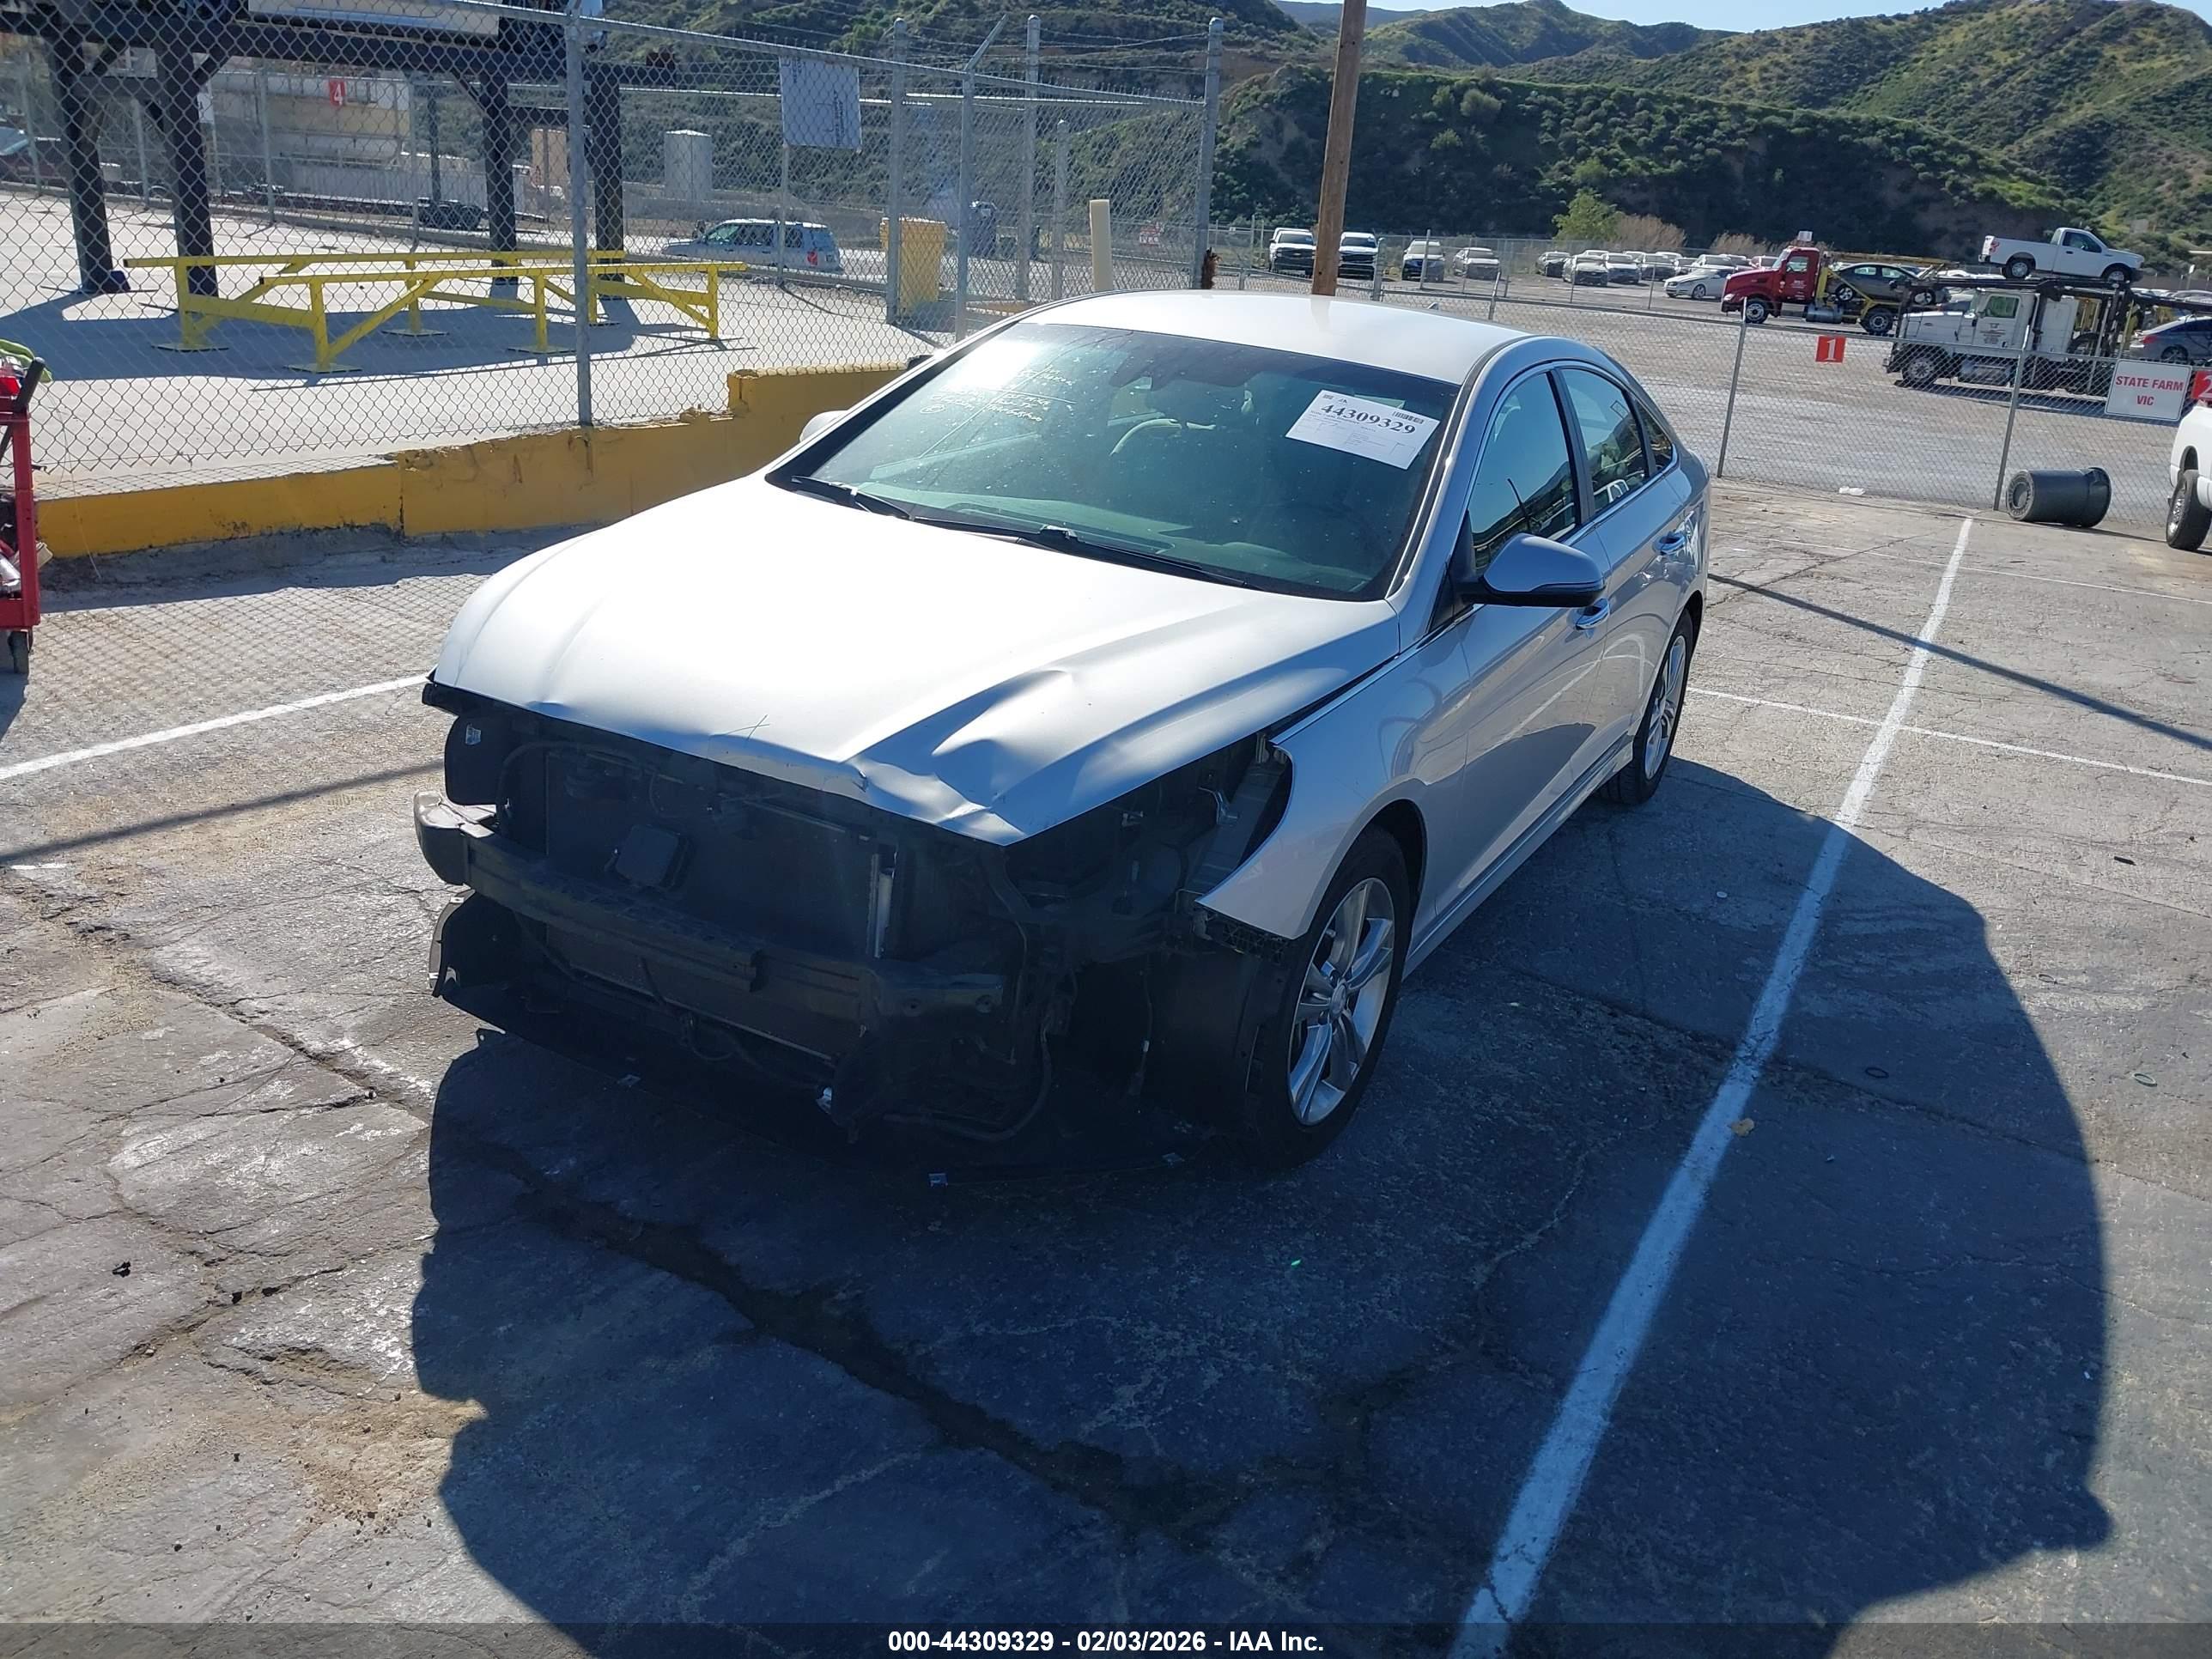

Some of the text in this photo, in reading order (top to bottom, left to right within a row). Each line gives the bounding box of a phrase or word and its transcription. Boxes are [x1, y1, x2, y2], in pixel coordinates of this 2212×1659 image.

[333, 82, 343, 106] 4
[1825, 338, 1837, 361] 1
[2115, 375, 2184, 392] STATE FARM
[2136, 395, 2154, 406] VIC
[1321, 404, 1416, 434] 44309329
